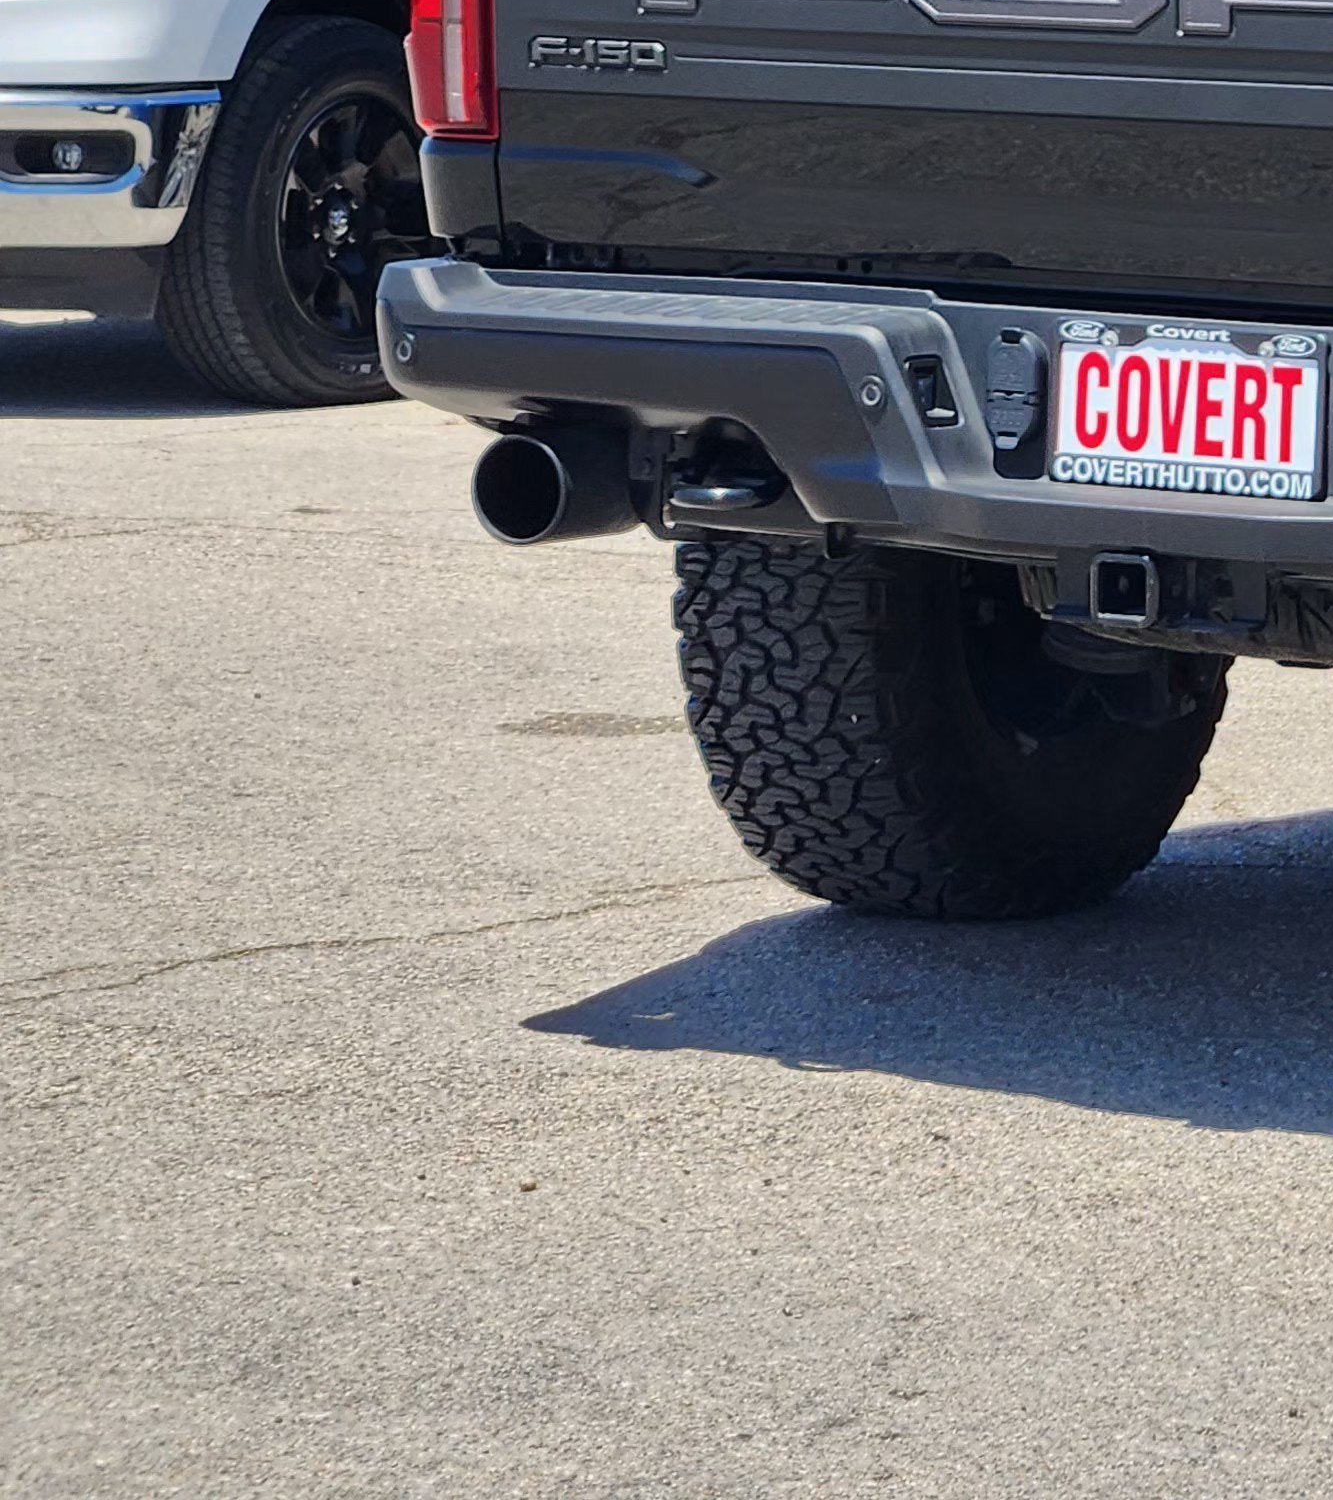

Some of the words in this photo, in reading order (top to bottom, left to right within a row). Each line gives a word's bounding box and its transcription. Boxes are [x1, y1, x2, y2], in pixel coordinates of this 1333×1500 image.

[530, 36, 666, 71] F-150
[1146, 324, 1231, 342] Covert
[1074, 351, 1304, 463] COVERT
[1055, 456, 1312, 499] COVERTHUTTO.COM
